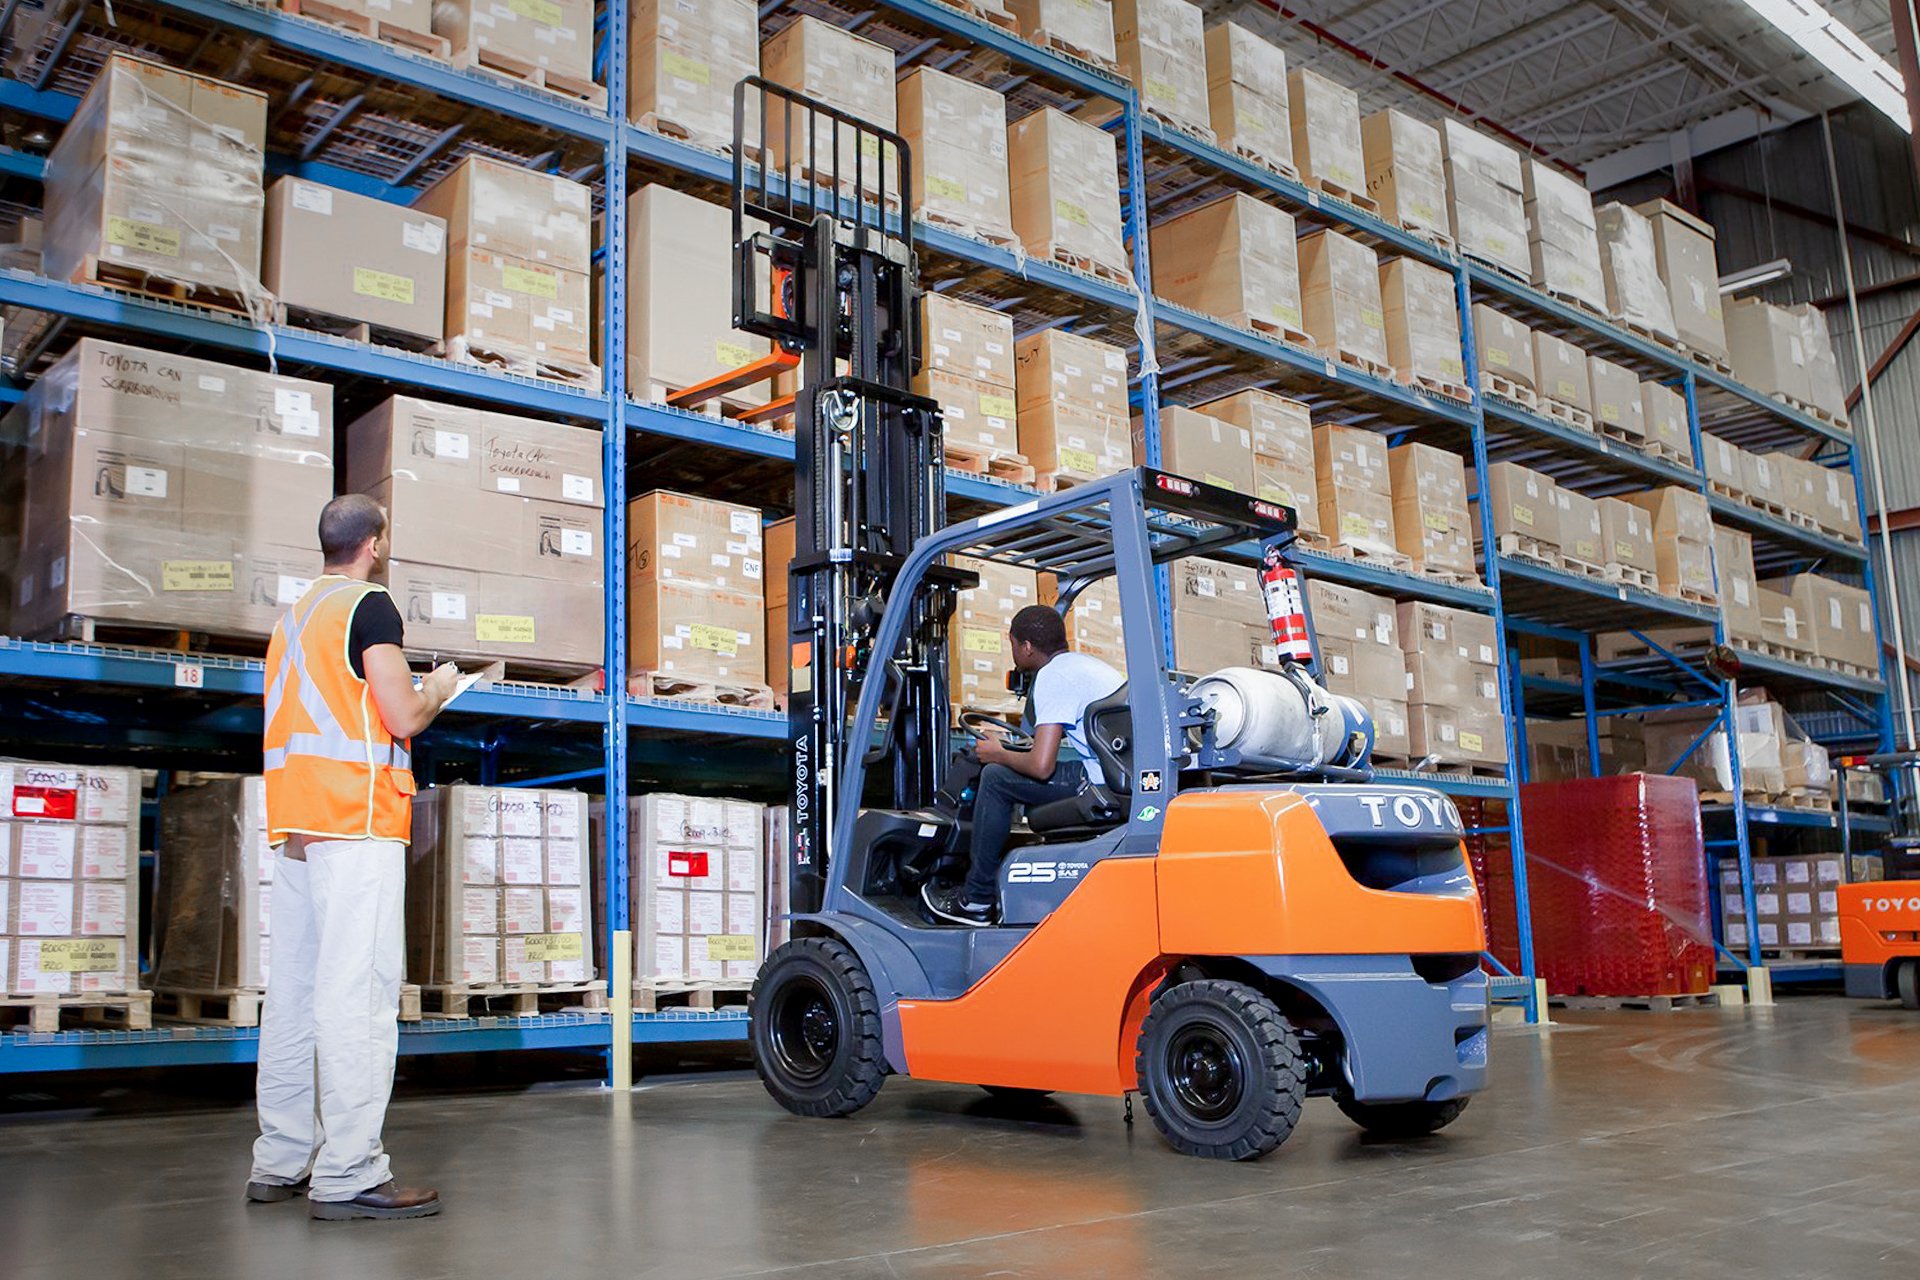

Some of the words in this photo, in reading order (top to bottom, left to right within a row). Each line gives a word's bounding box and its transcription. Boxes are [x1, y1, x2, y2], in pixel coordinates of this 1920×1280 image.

[98, 350, 149, 373] TOYOTA
[744, 562, 760, 573] CNF
[183, 668, 199, 683] 18
[796, 734, 809, 824] TOYOTA
[1358, 795, 1461, 829] TOYO
[1007, 862, 1057, 883] 25
[1057, 869, 1079, 877] SAS
[1861, 897, 1920, 912] TOYO
